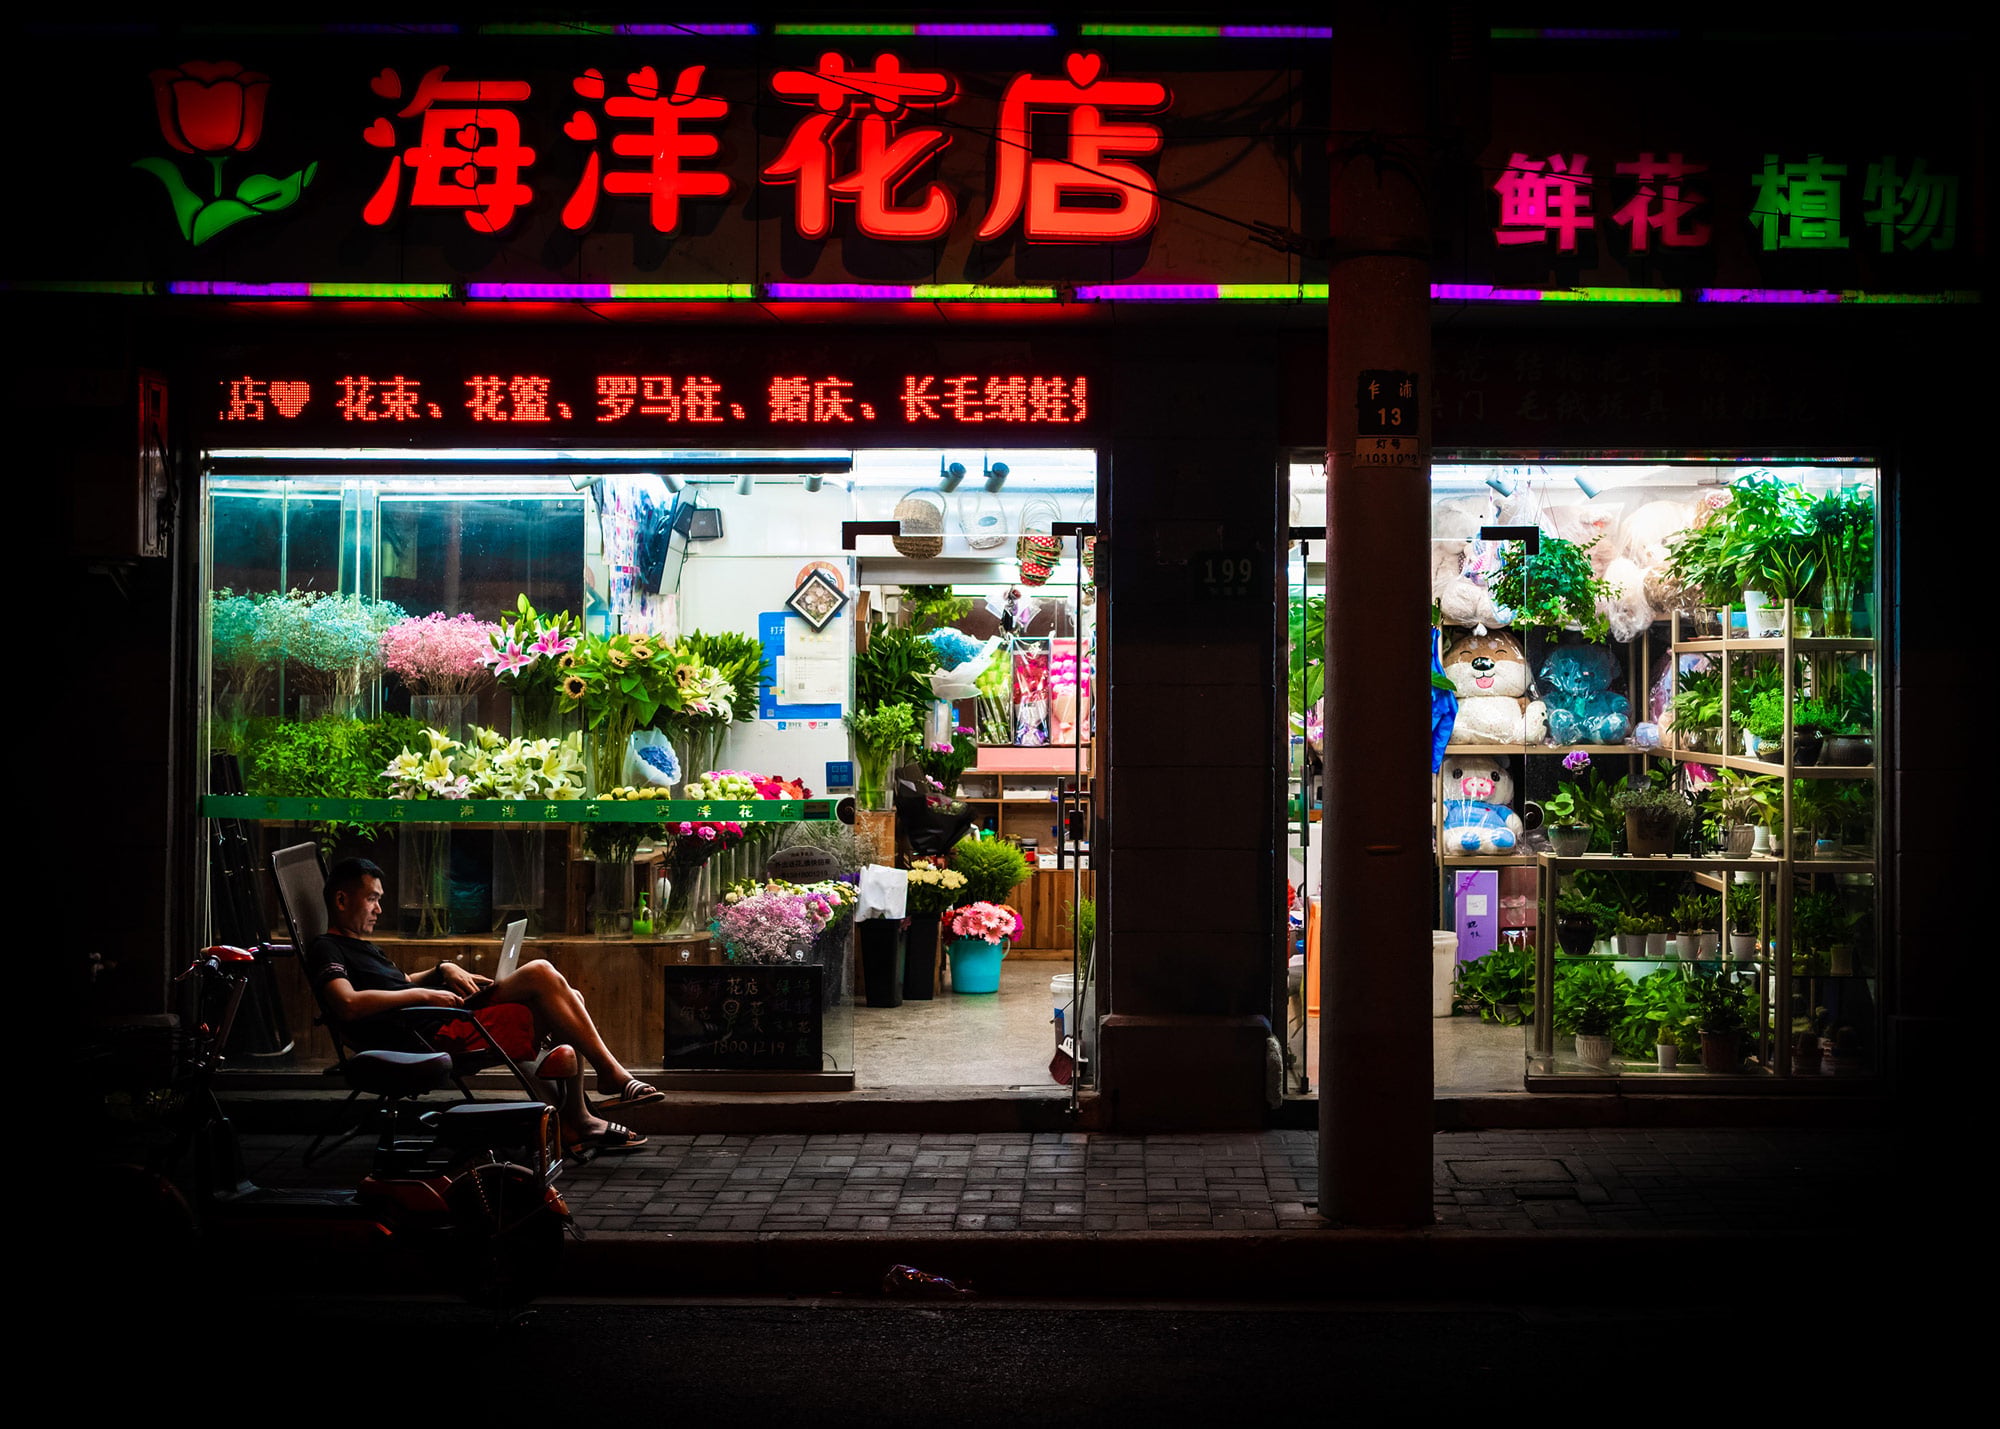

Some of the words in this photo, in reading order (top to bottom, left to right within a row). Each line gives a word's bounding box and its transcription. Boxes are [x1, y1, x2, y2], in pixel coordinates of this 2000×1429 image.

[363, 53, 1167, 244] 海洋花店
[1493, 152, 1713, 253] 鲜花
[1749, 153, 1960, 253] 植物
[220, 376, 267, 420] 店
[1367, 379, 1414, 400] 乍浦
[1376, 407, 1403, 427] 13
[1376, 439, 1401, 450] 灯号
[1202, 558, 1253, 584] 199
